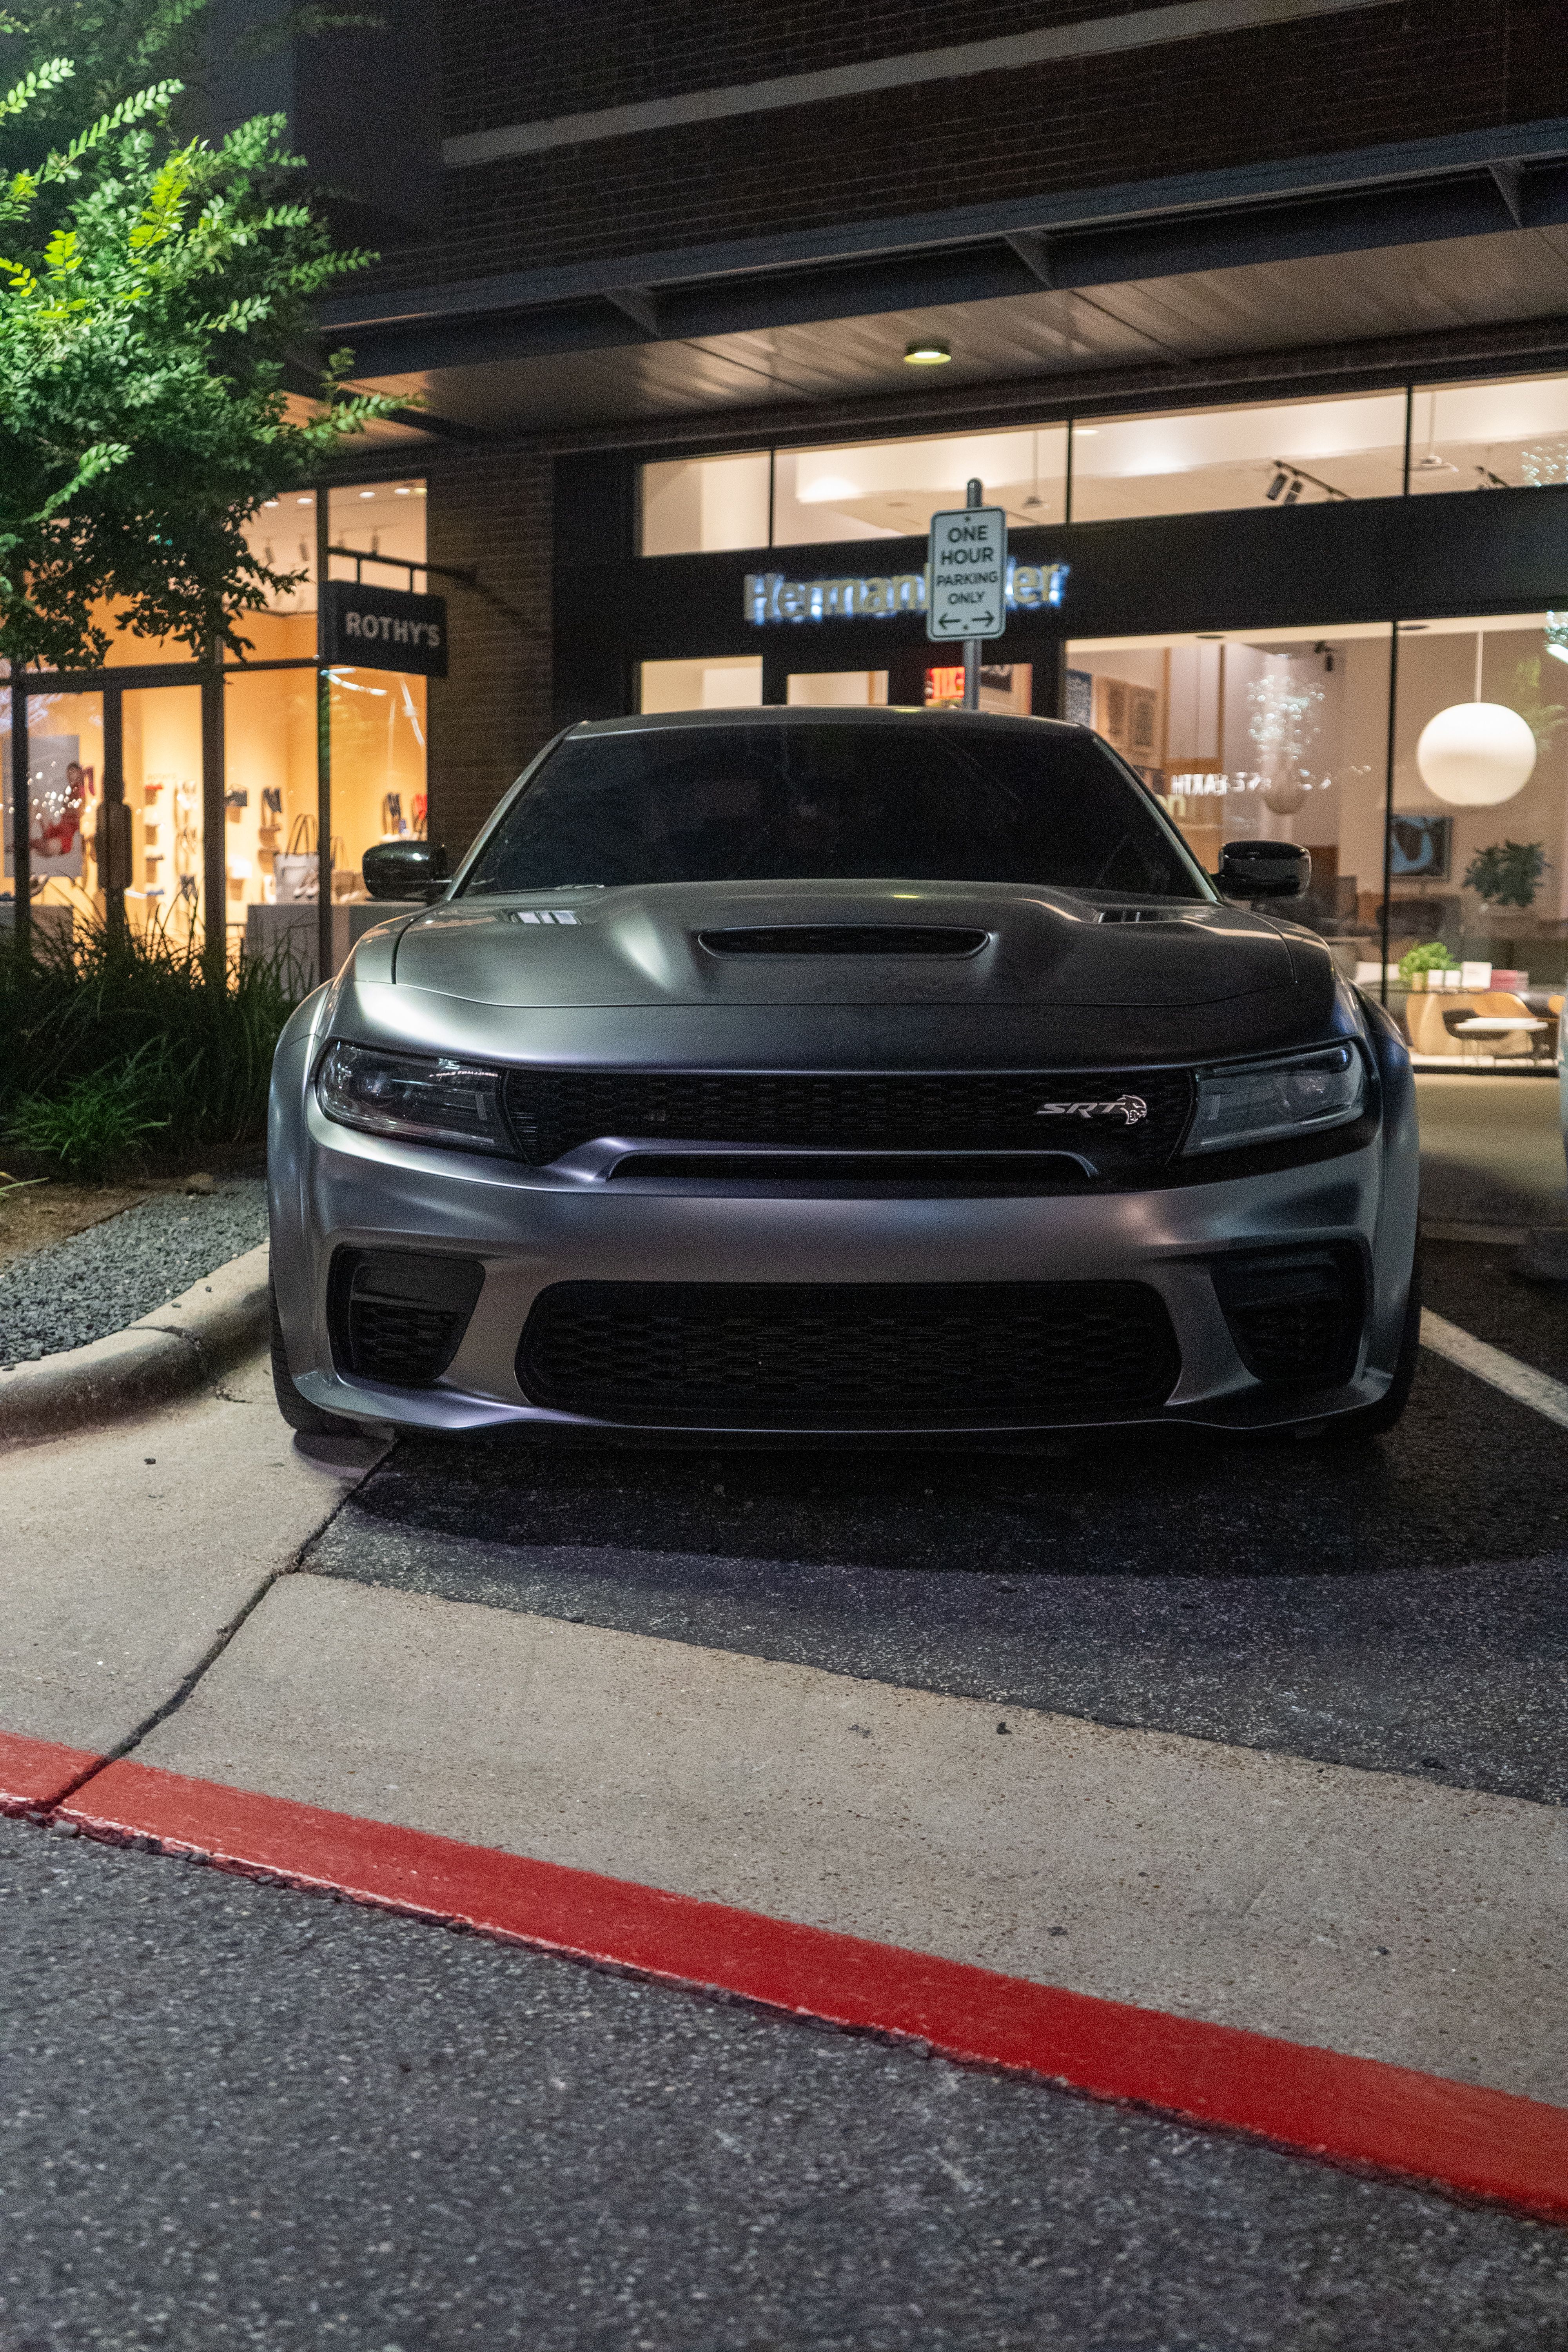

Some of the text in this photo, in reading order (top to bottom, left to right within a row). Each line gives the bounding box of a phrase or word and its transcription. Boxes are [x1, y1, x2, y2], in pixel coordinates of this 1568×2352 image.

[948, 525, 988, 542] ONE
[941, 547, 994, 565] HOUR
[936, 571, 998, 586] PARKING
[745, 573, 924, 624] Herman
[948, 592, 986, 604] ONLY
[1036, 1103, 1125, 1118] SRT
